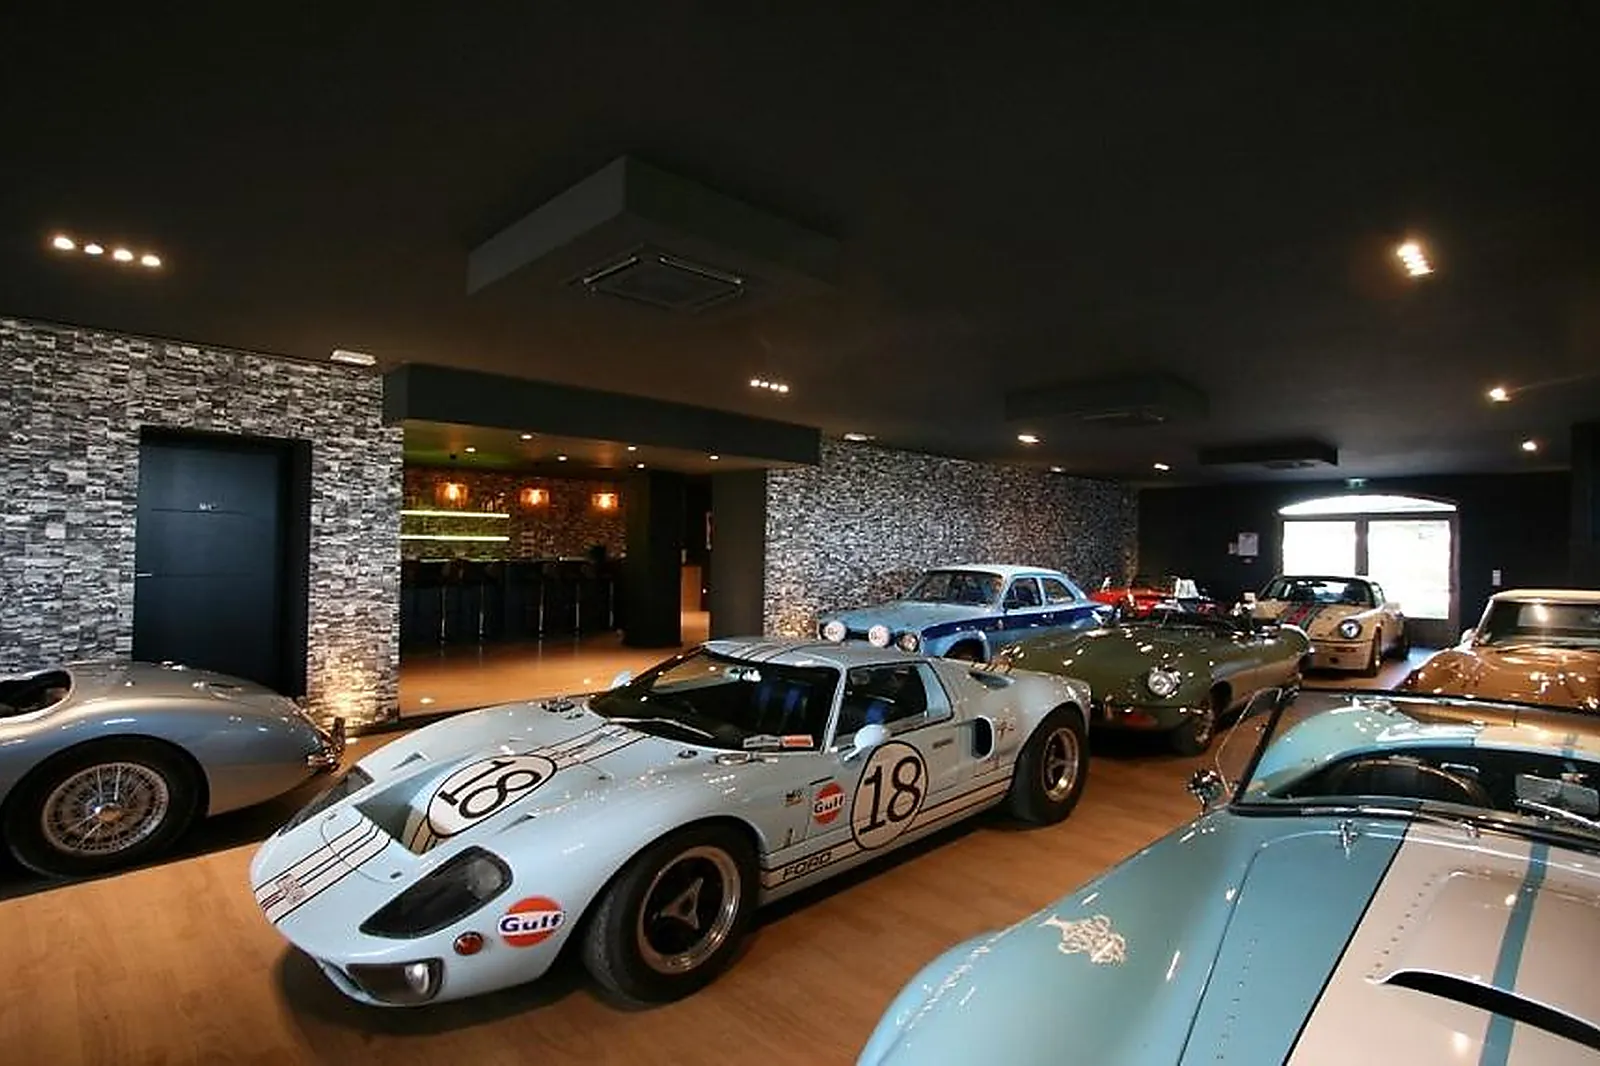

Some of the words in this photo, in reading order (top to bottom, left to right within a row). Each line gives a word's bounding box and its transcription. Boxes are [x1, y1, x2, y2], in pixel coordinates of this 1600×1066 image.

[438, 760, 542, 819] 18
[858, 756, 922, 836] 18
[814, 795, 845, 814] Gulf
[783, 851, 832, 880] FORD
[500, 913, 562, 933] Gulf
